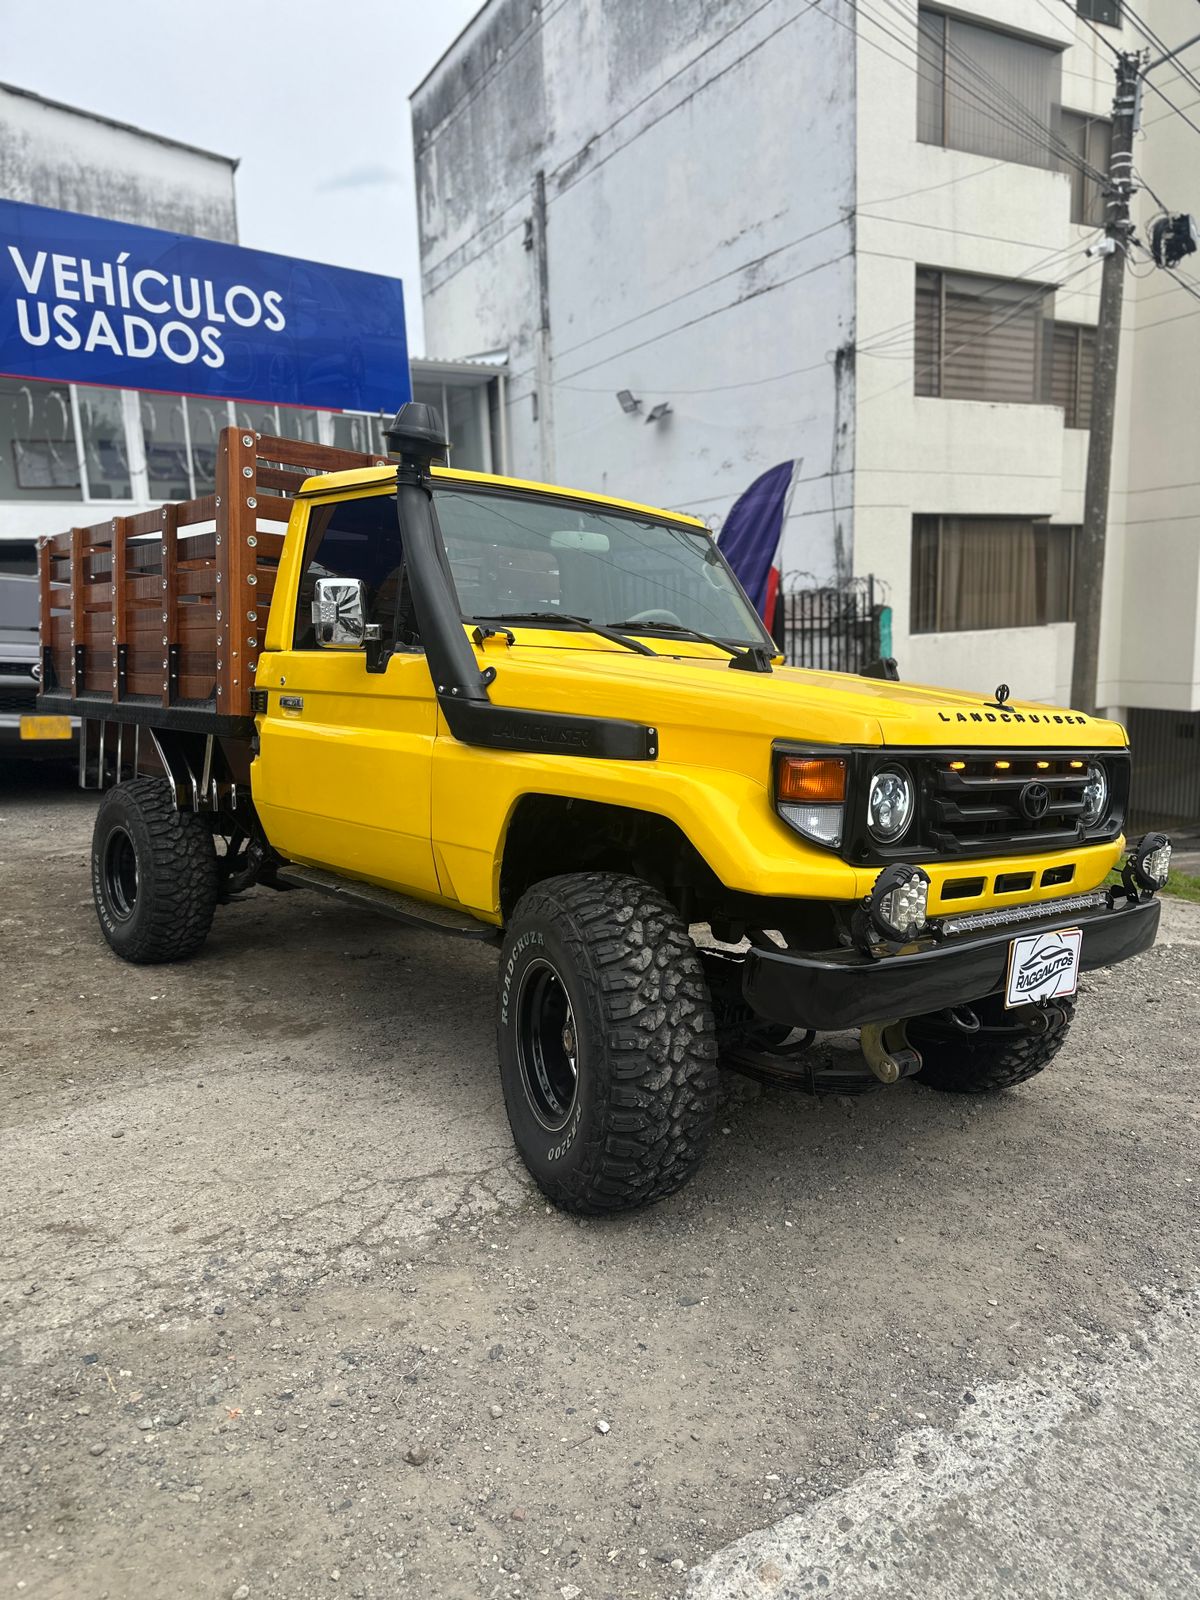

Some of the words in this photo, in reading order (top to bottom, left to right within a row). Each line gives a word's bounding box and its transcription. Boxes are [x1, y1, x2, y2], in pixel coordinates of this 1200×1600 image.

[7, 246, 286, 331] VEHÍCULOS
[16, 298, 225, 368] USADOS
[938, 712, 1087, 725] LANDCRUISER
[501, 931, 545, 1026] ROADCRUZA
[1016, 956, 1074, 989] RAGGAUTOS
